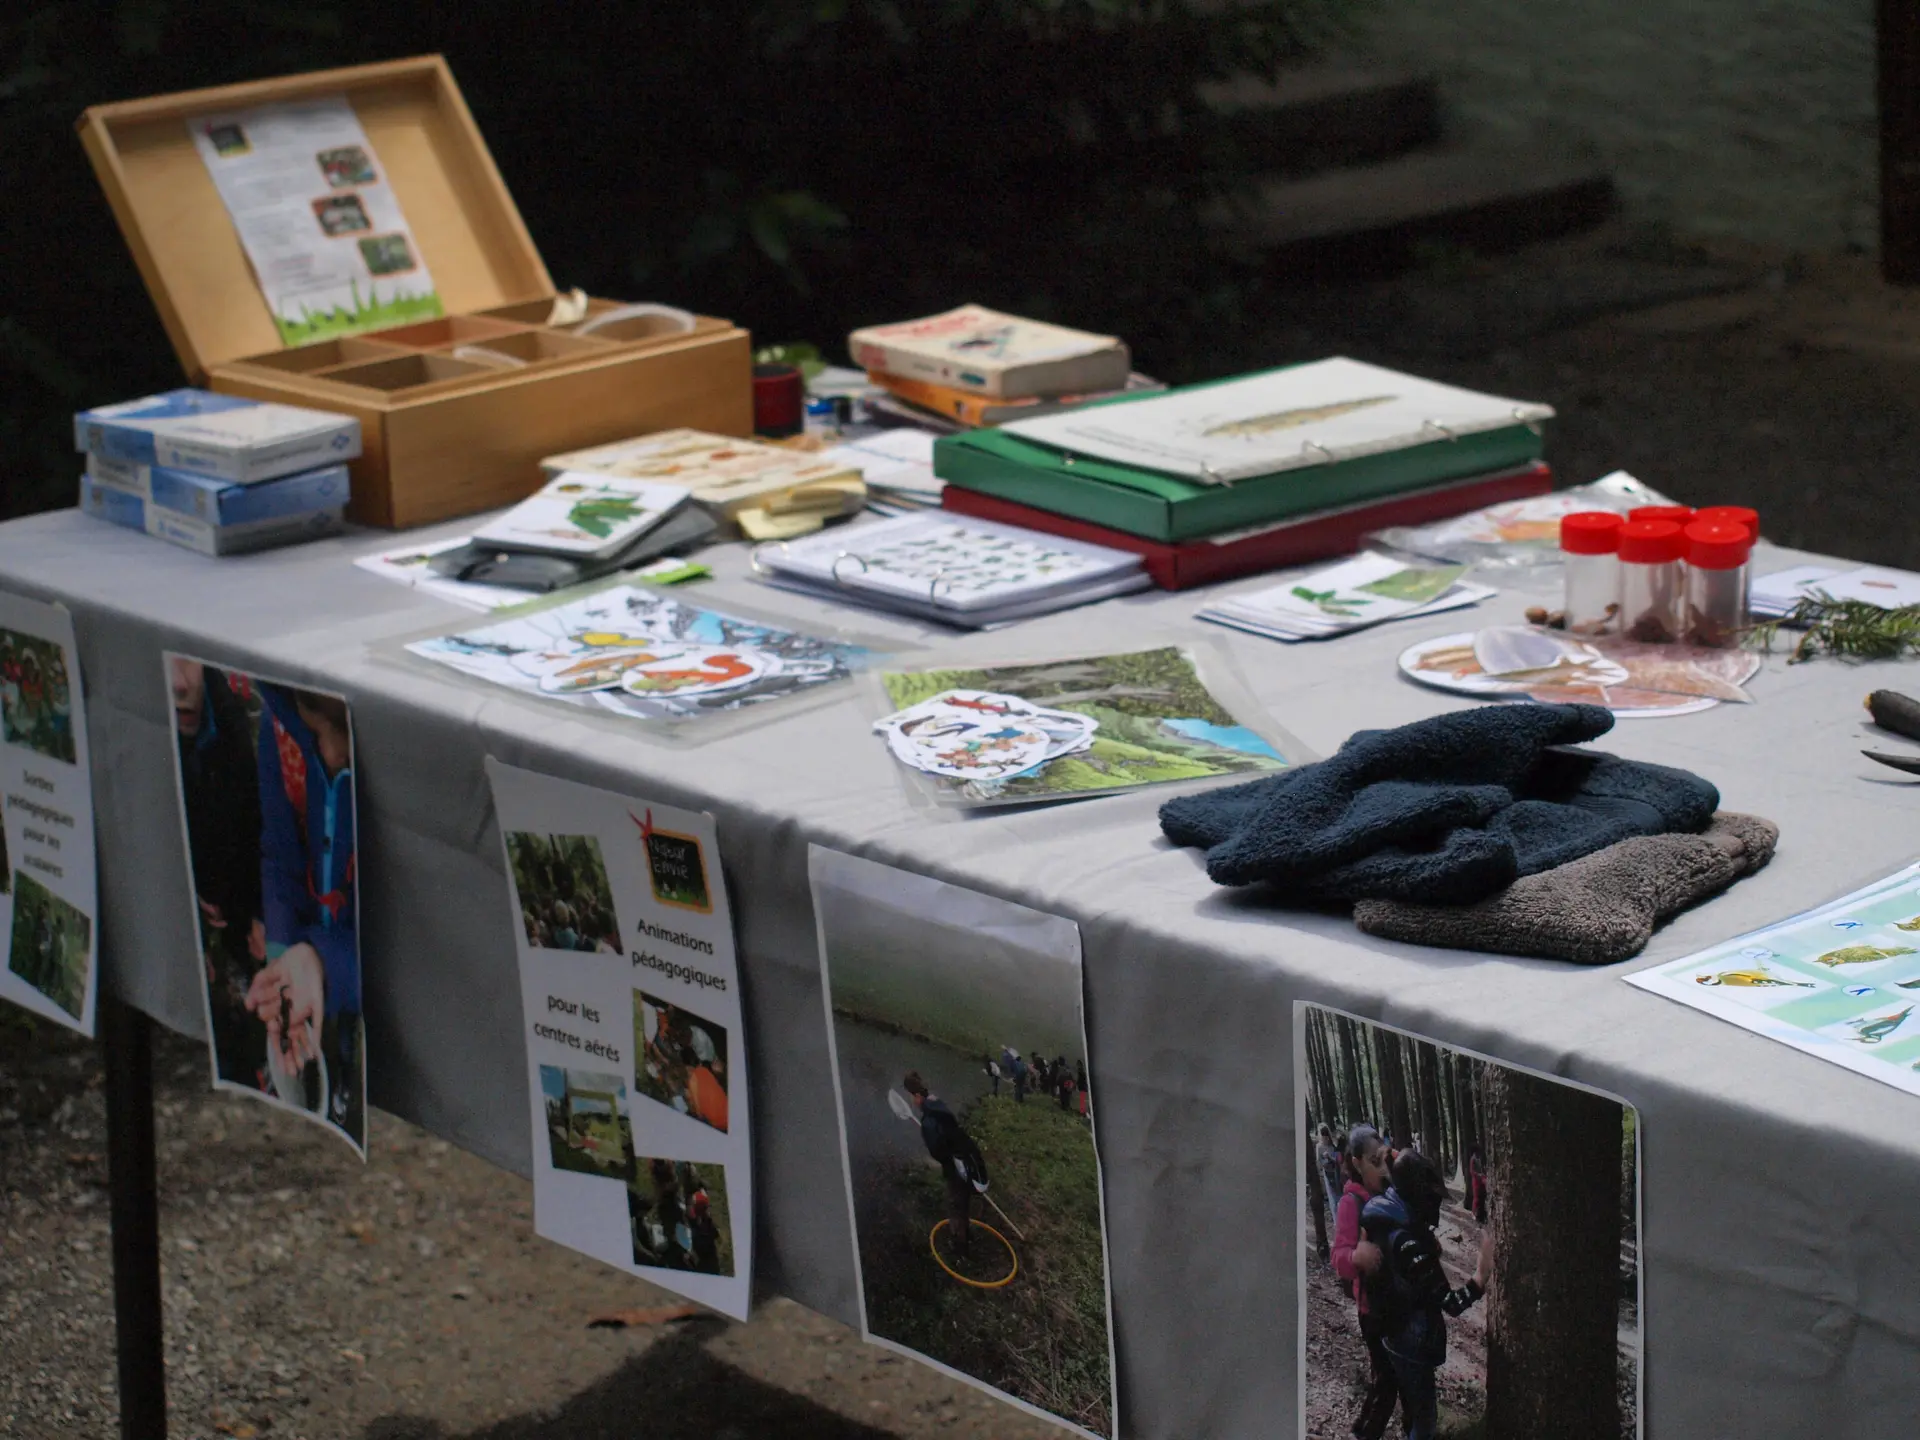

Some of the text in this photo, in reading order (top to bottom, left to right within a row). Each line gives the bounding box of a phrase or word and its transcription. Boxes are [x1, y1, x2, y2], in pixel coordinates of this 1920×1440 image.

[637, 918, 714, 955] Animations
[632, 950, 728, 991] pédagogiques
[547, 994, 601, 1024] pour les
[533, 1021, 621, 1063] centres aérés
